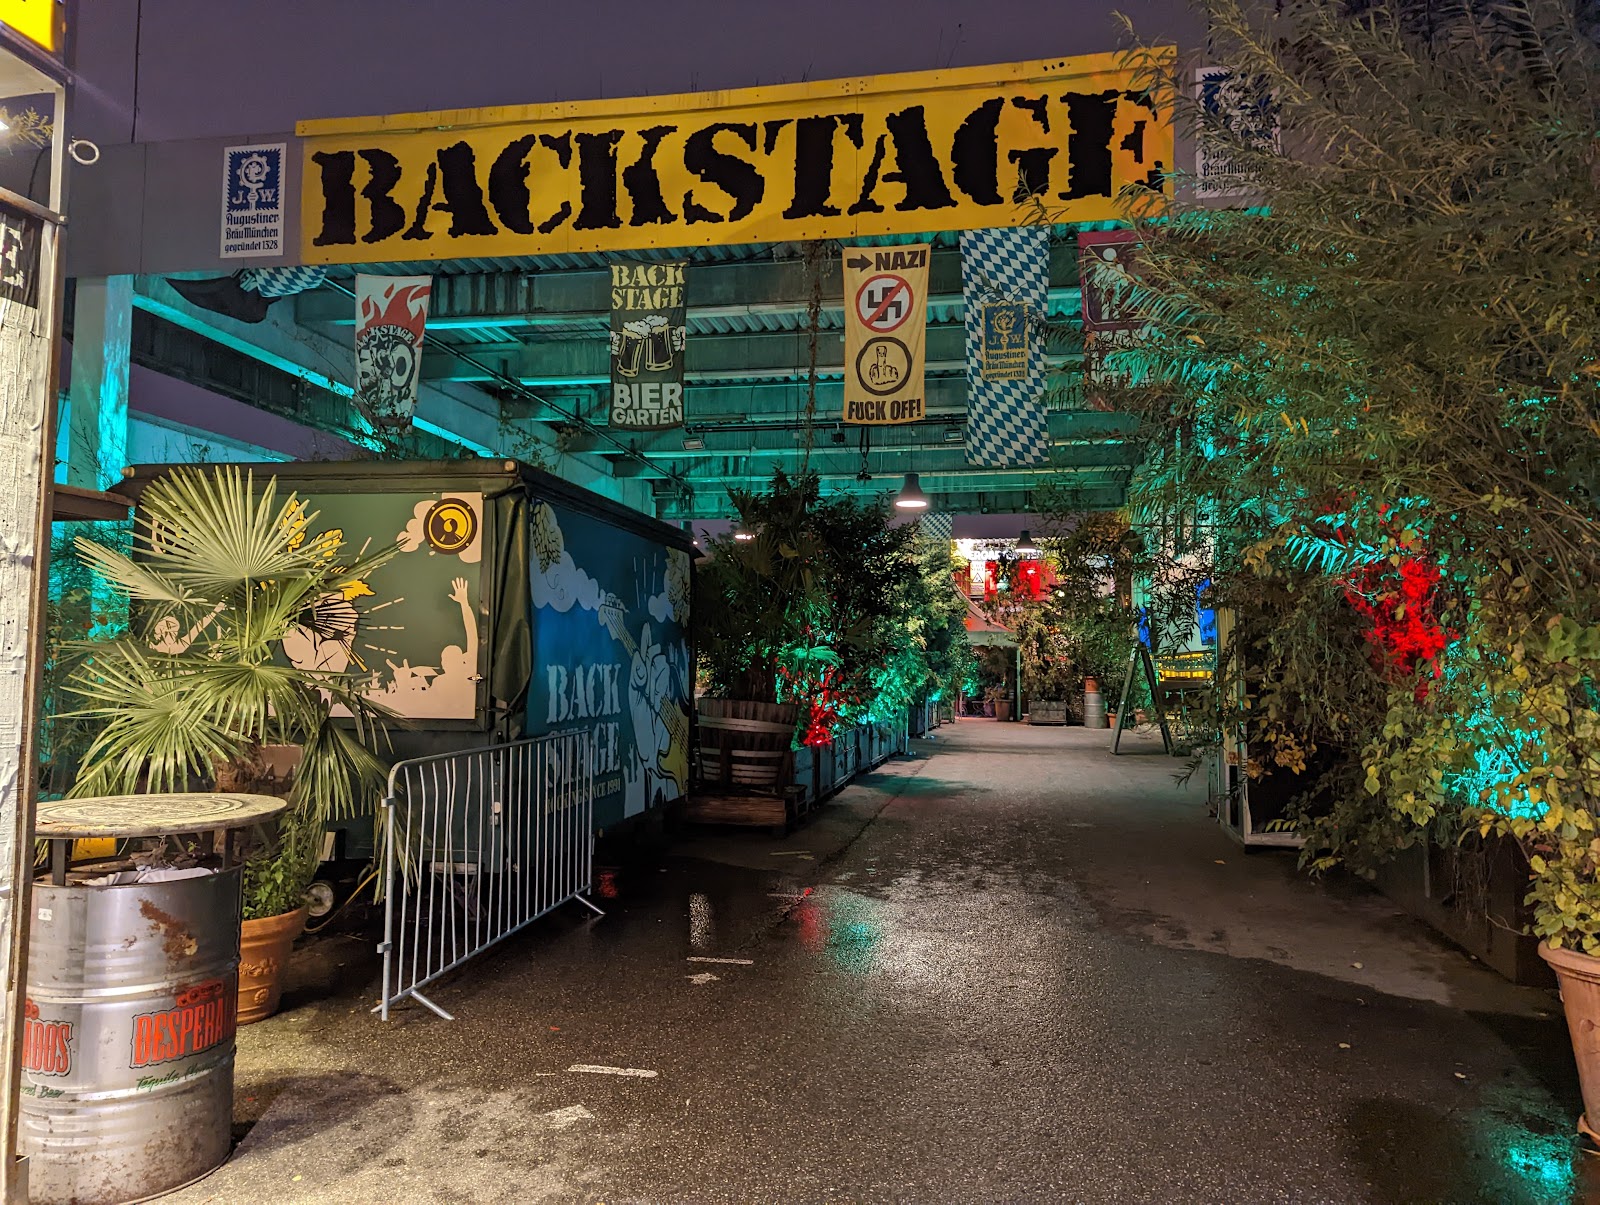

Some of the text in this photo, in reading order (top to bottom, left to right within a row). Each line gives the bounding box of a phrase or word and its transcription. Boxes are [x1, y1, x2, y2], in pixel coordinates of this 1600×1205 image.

[312, 90, 1163, 246] BACKSTAGE
[225, 226, 278, 240] Bräu München
[224, 239, 278, 254] gegründet 1328
[875, 249, 927, 271] NAZI
[611, 262, 687, 287] BACK
[611, 286, 684, 310] STAGE
[613, 382, 683, 410] BIER
[612, 406, 683, 426] GARTEN
[847, 398, 922, 421] FUCK OFF!
[546, 662, 622, 724] BACK
[545, 721, 622, 788] STAGE
[584, 781, 607, 801] SNCE
[134, 997, 231, 1065] DESPERA
